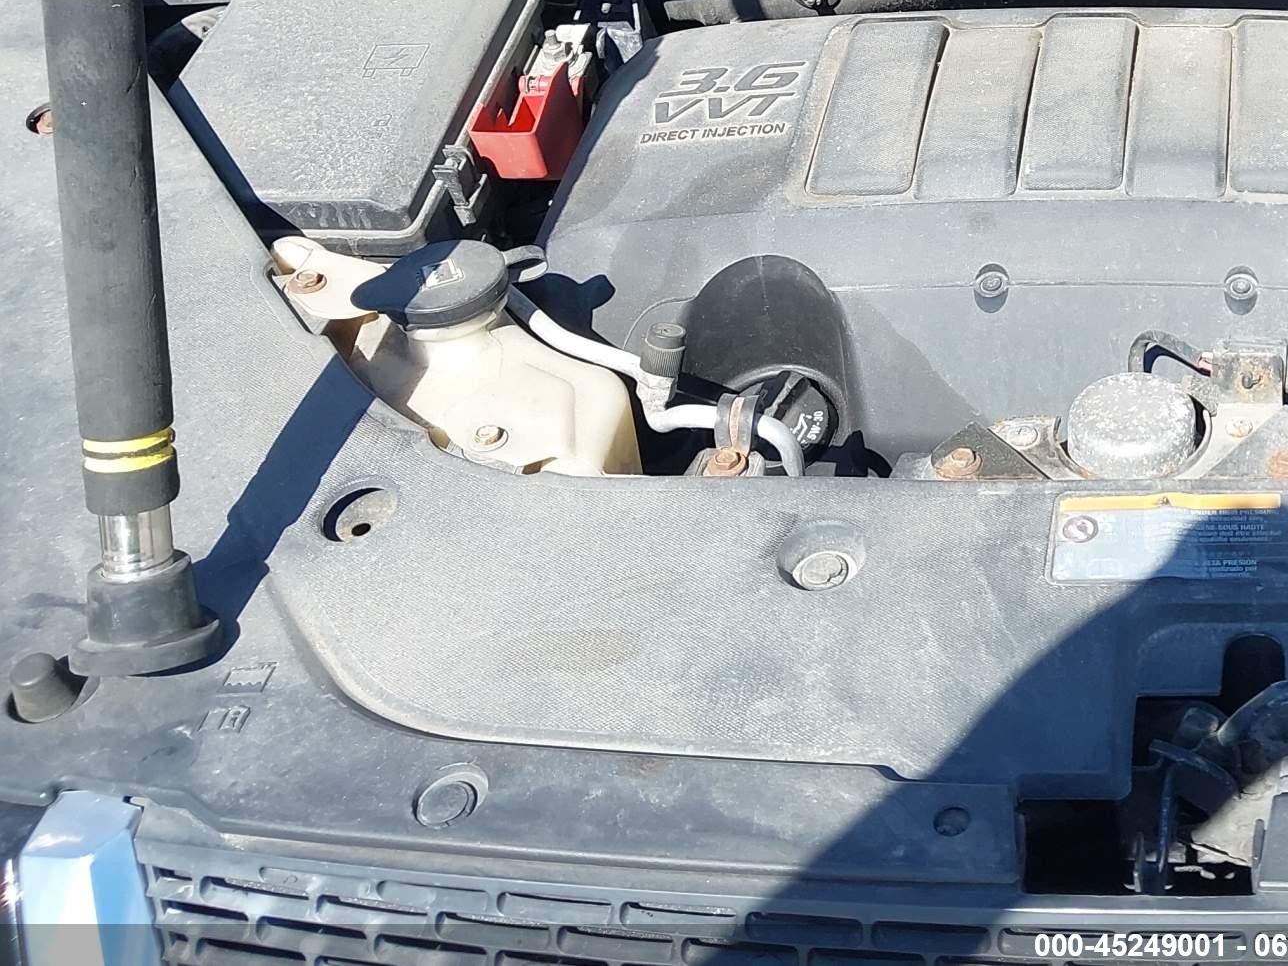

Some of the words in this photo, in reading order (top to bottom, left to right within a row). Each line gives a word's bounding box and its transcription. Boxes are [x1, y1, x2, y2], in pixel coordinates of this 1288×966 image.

[659, 61, 807, 98] 3.6
[655, 91, 796, 124] VVT
[640, 128, 699, 144] DIRECT
[701, 123, 786, 139] INJECTION
[807, 410, 824, 440] 5W-30
